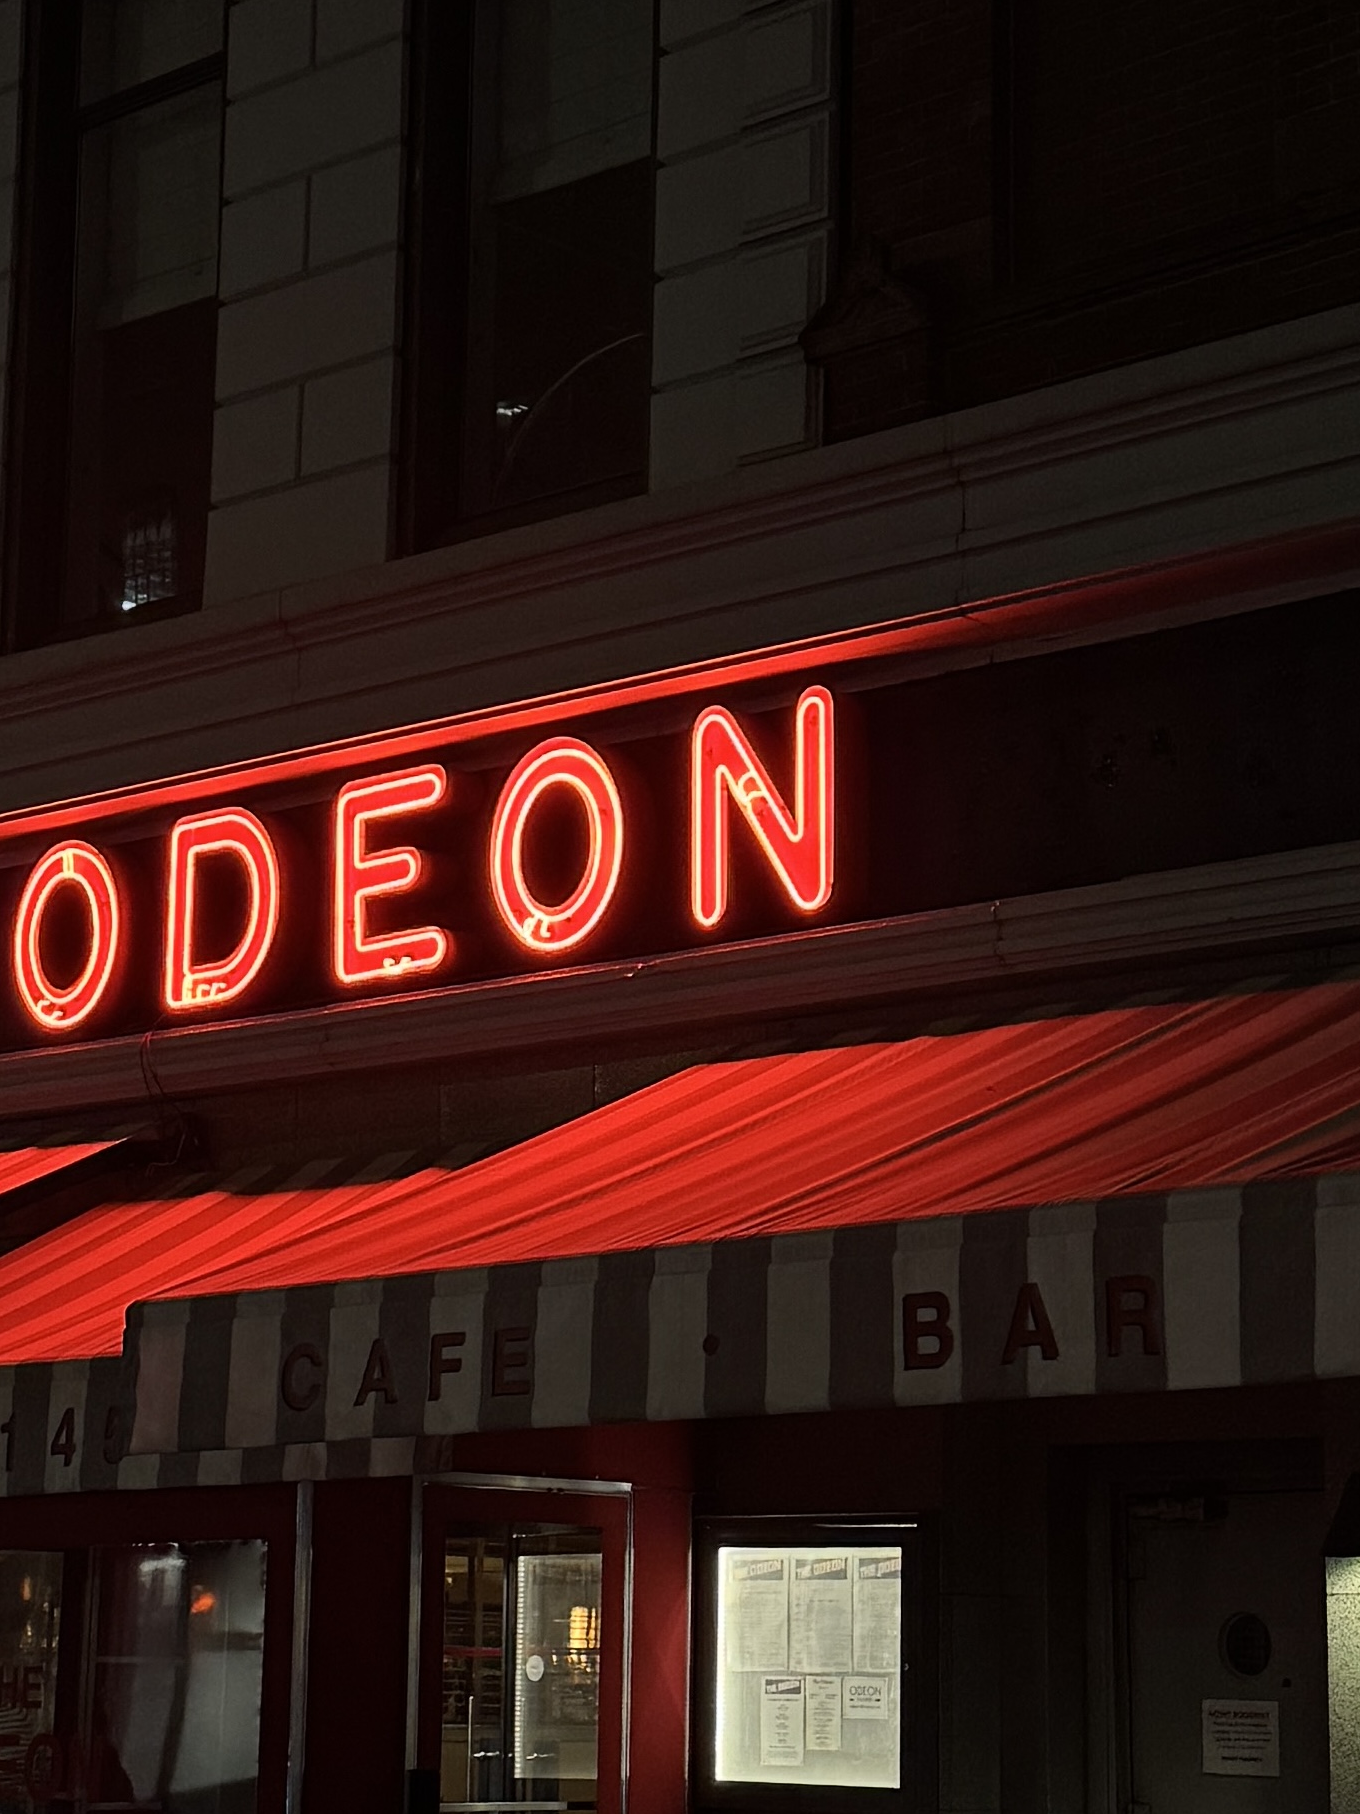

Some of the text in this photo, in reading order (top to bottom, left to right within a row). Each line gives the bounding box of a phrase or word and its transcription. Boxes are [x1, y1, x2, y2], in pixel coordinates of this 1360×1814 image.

[14, 685, 834, 1031] ODEON
[281, 1274, 1162, 1412] CAFE BAR
